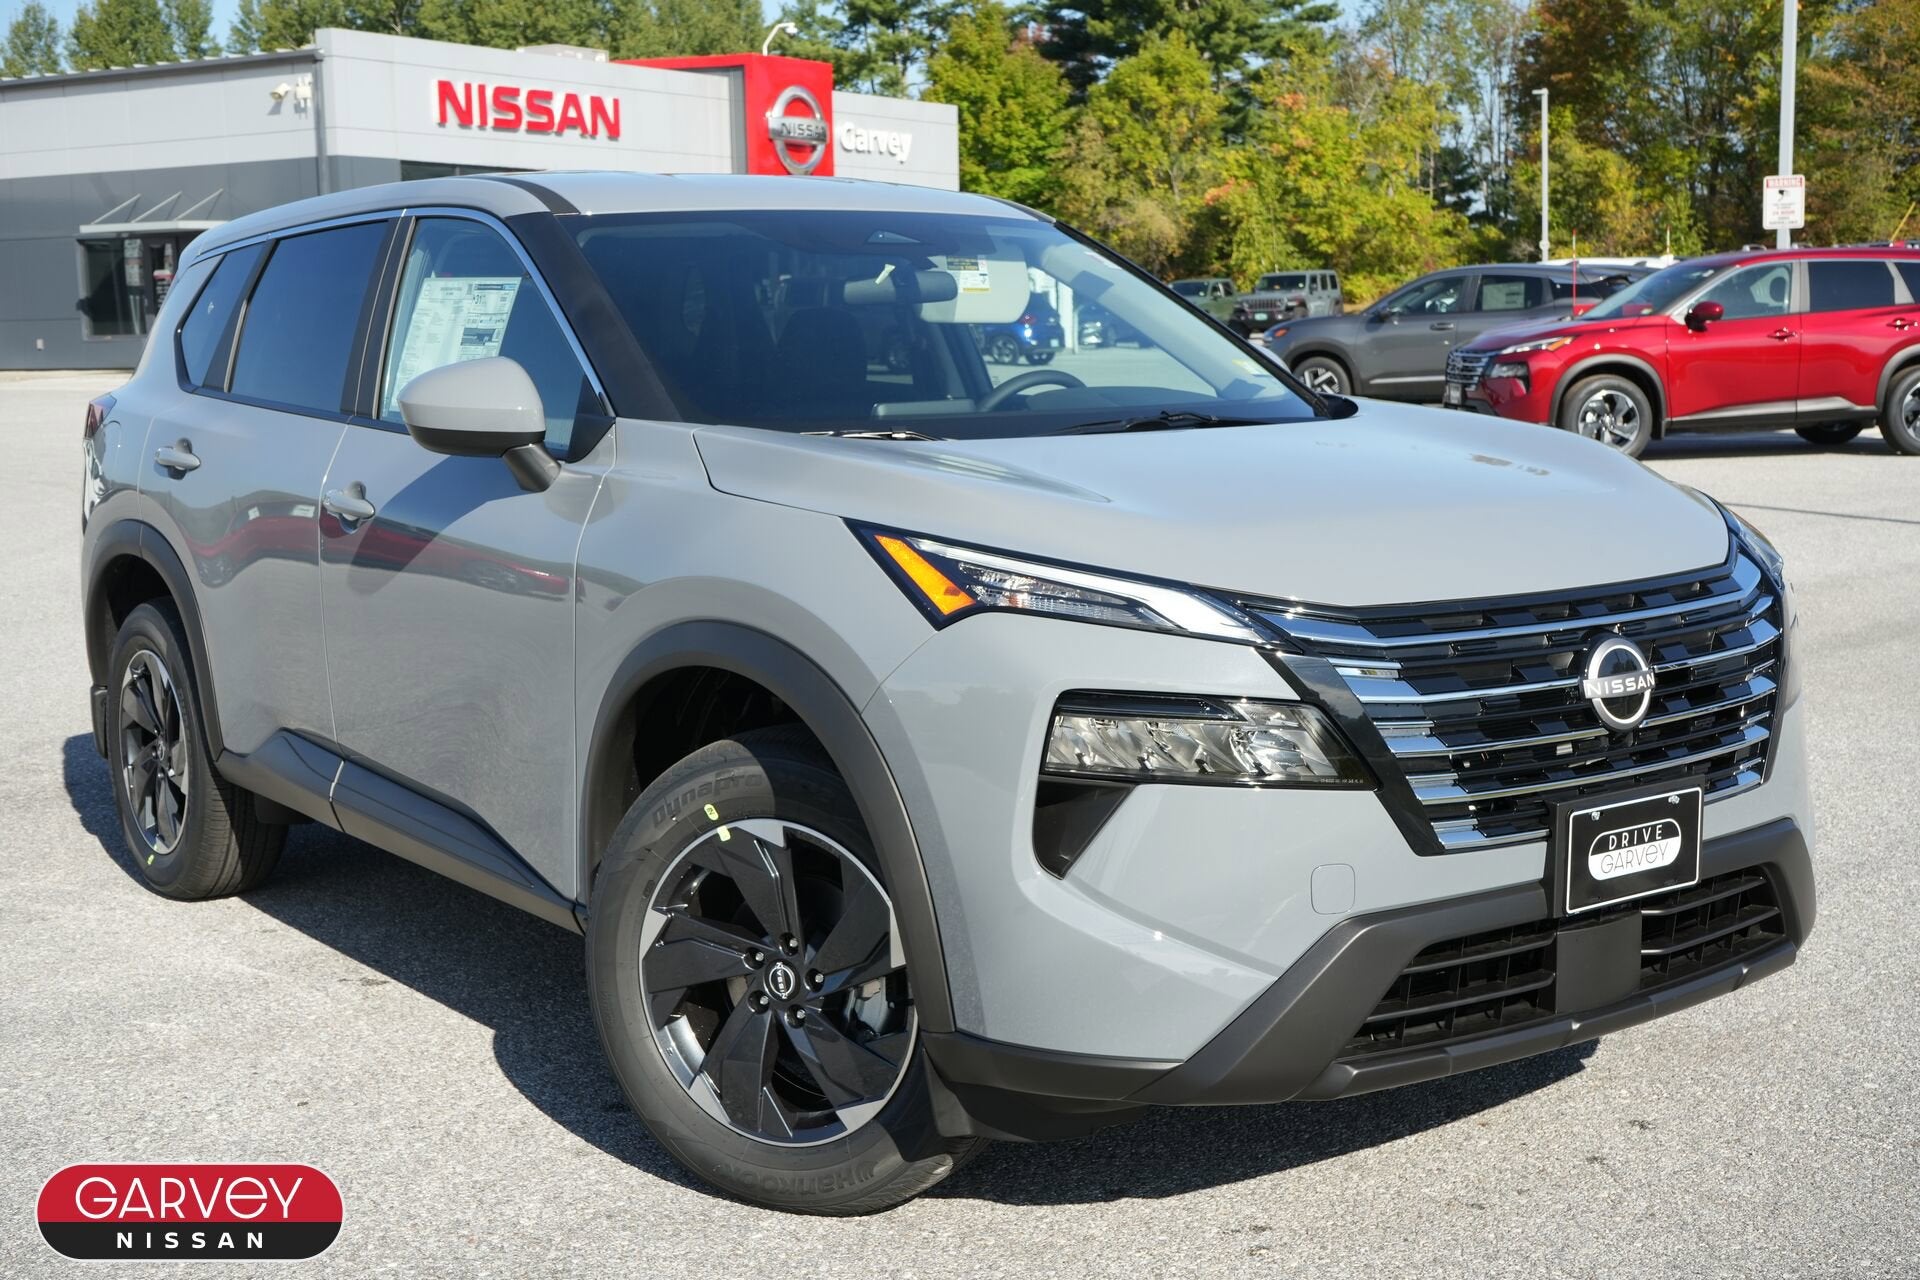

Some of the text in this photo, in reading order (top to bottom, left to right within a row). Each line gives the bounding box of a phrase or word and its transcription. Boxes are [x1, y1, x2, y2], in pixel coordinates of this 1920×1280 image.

[435, 79, 621, 138] NISSAN
[840, 123, 912, 162] Garvey
[1585, 672, 1656, 697] NISSAN
[1608, 824, 1663, 851] DRIVE
